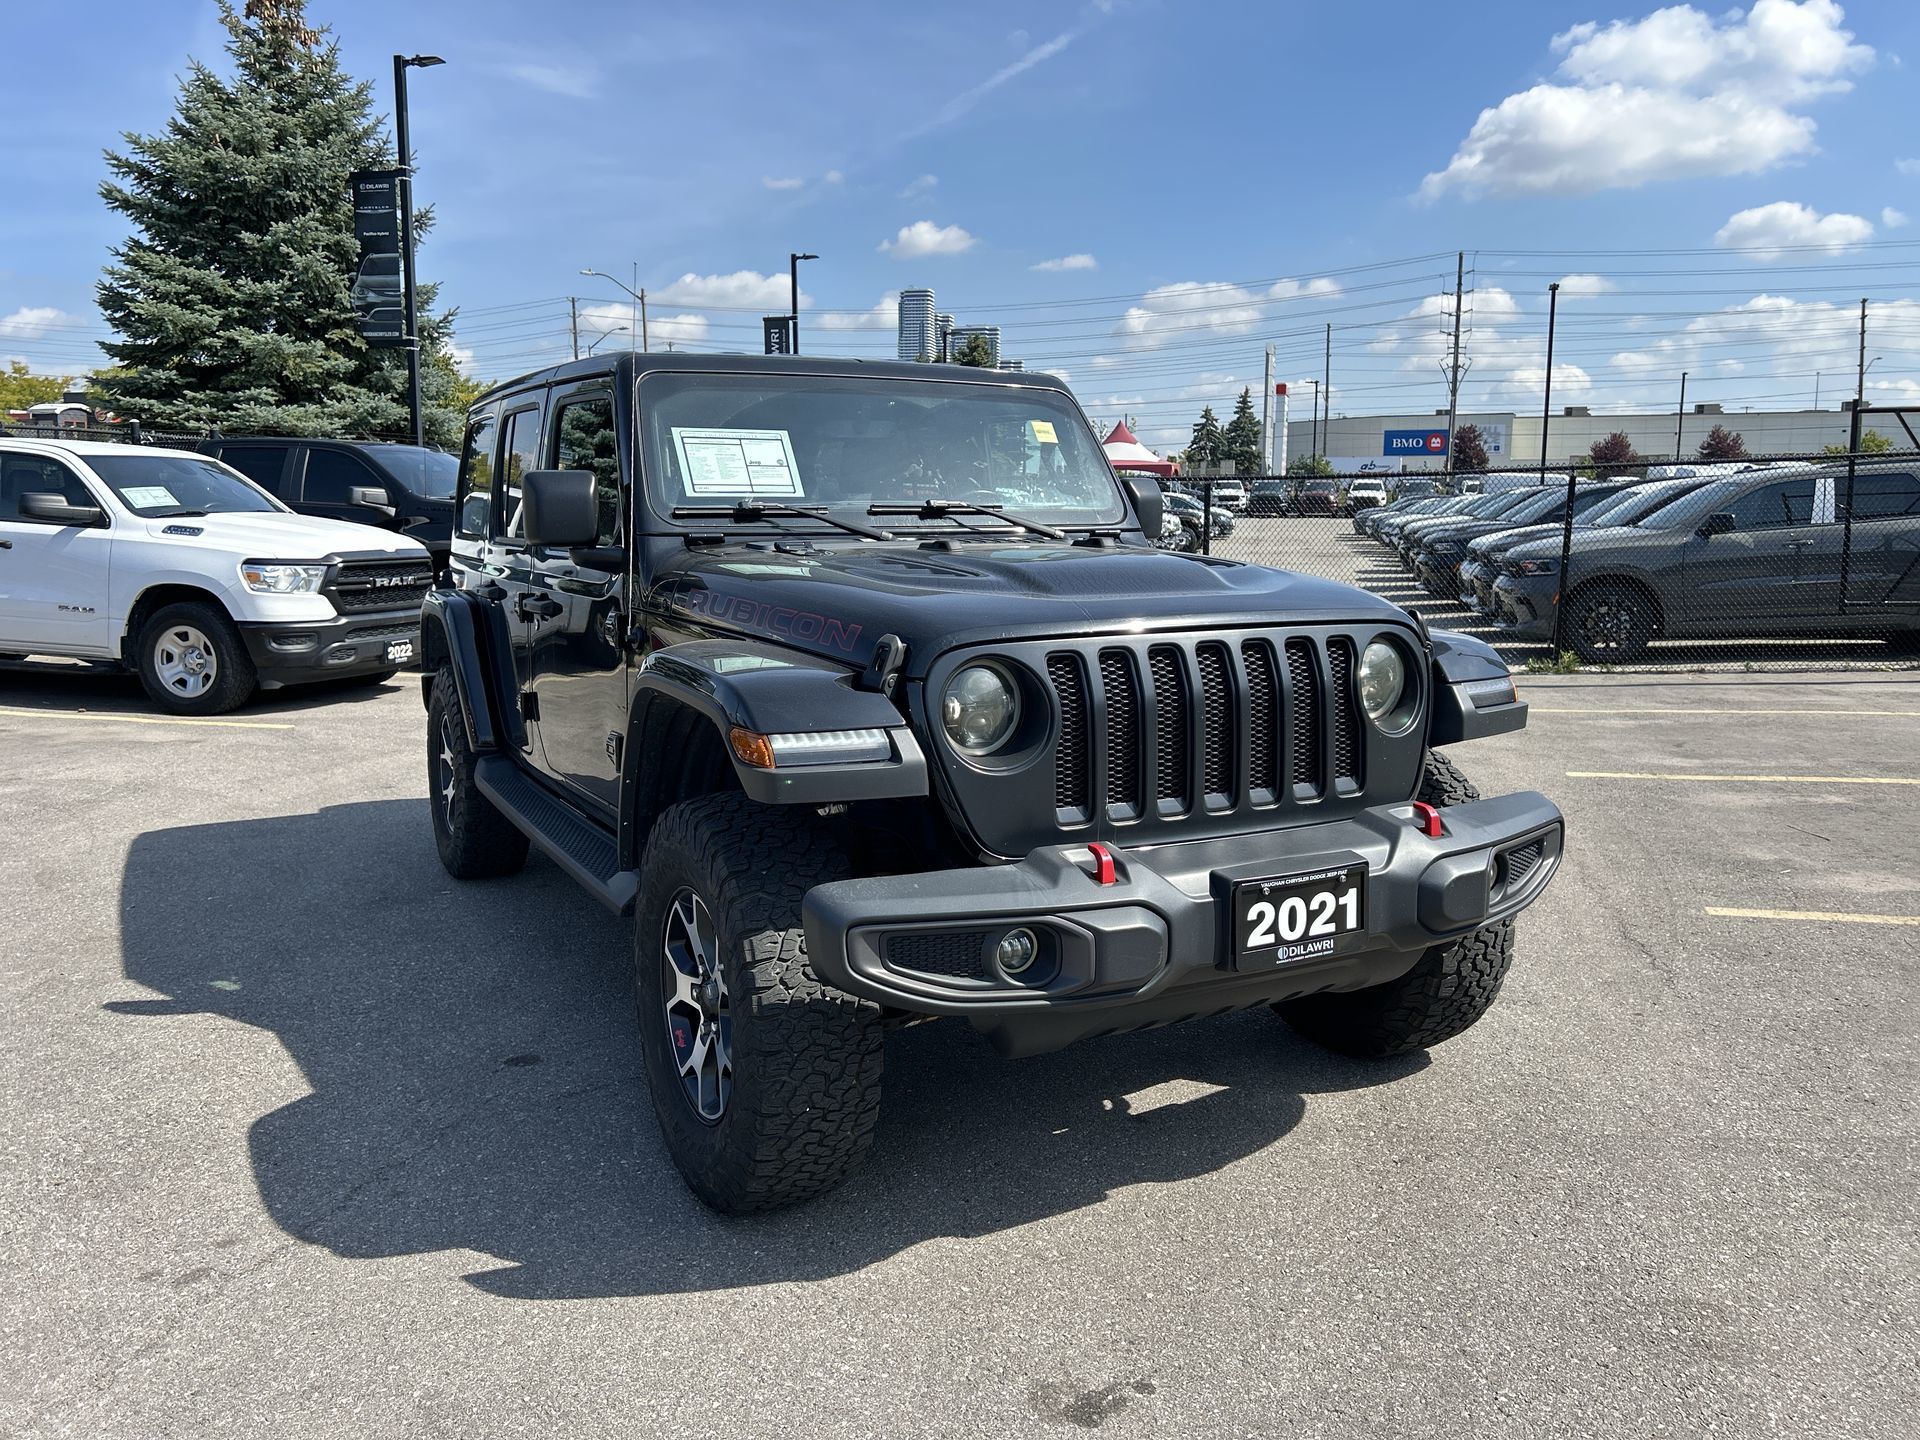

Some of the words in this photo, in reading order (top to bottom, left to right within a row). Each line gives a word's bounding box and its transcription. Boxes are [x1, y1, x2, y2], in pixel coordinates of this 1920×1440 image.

[1392, 438, 1423, 448] BMO
[375, 576, 416, 587] RAM
[58, 605, 95, 613] RAM
[687, 588, 862, 651] RUBICON
[388, 644, 412, 659] 2022
[1261, 880, 1285, 888] VAUGHAN
[1285, 876, 1309, 884] CHRYSLER
[1310, 873, 1326, 881] DODGE
[1247, 888, 1357, 947] 2021
[1289, 939, 1334, 957] DILAWRI
